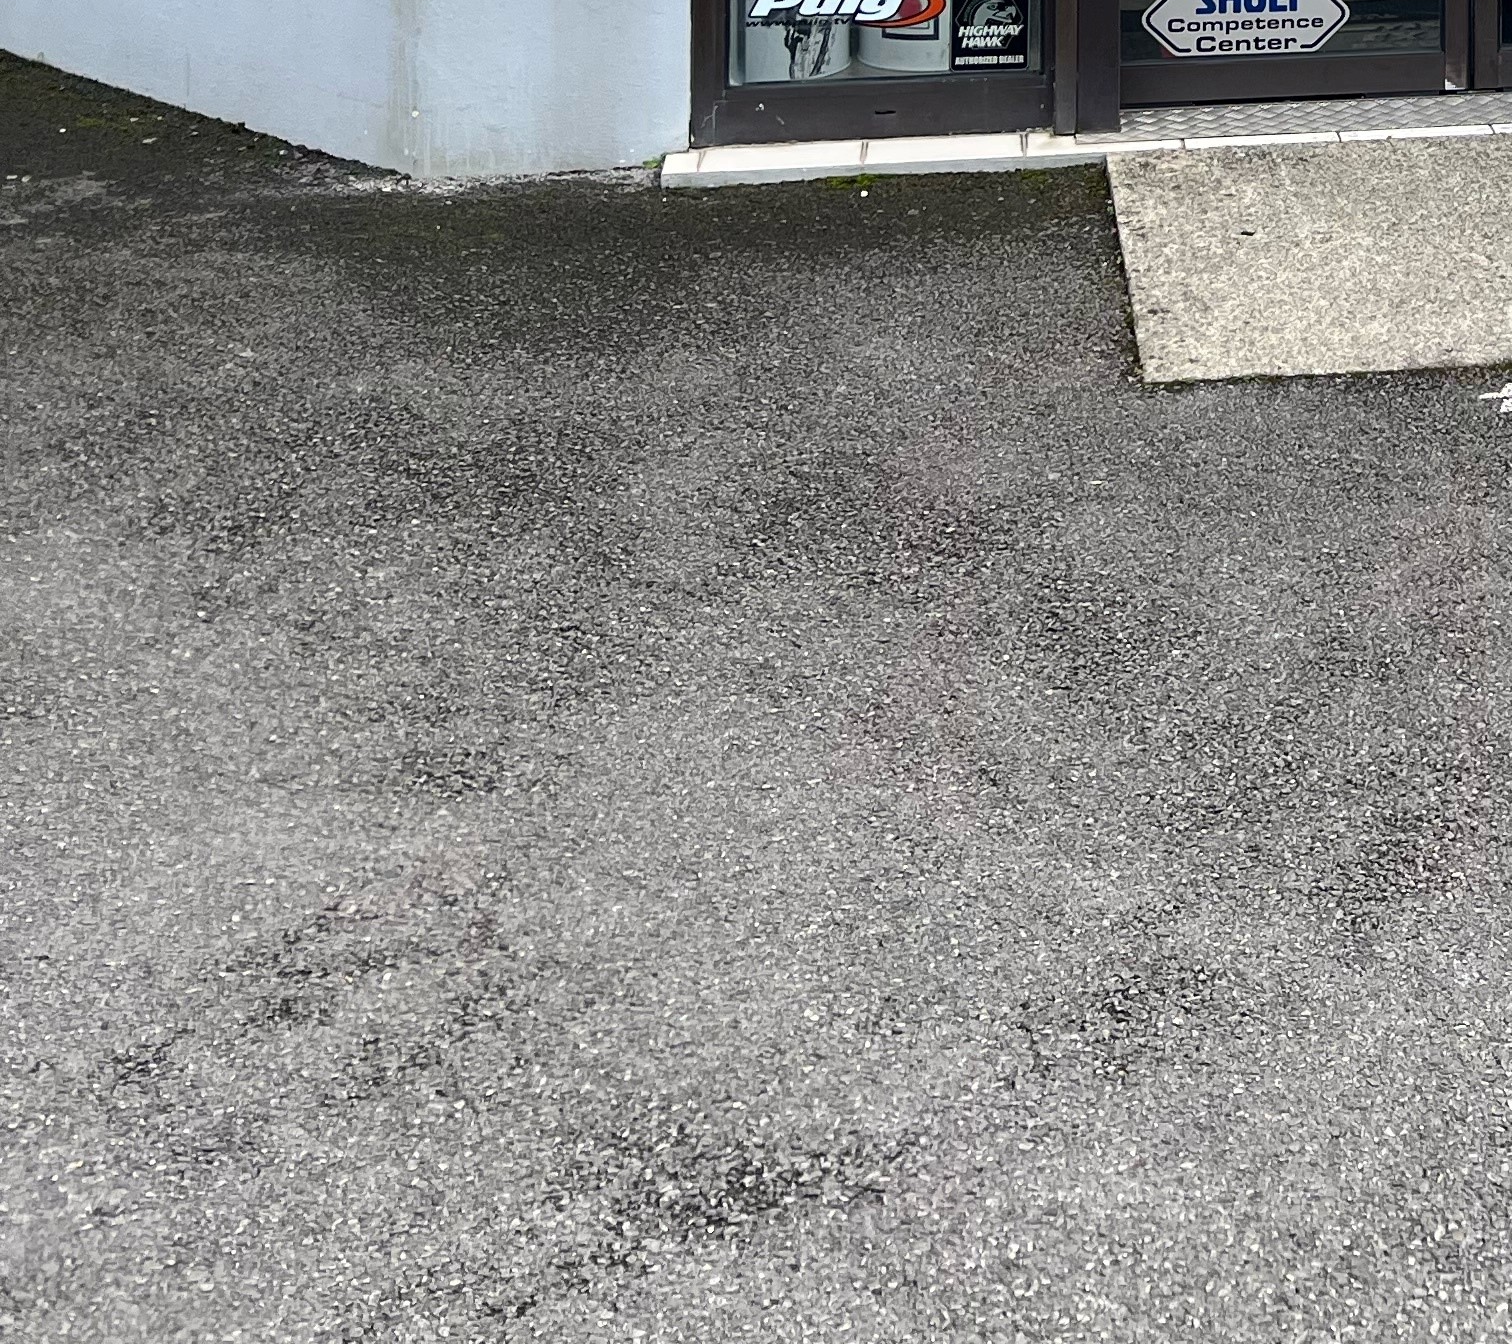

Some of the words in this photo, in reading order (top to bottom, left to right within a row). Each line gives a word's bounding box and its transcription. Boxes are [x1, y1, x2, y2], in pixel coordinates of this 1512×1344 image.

[958, 24, 1025, 38] HIGHWAY
[1167, 16, 1325, 35] Competence
[961, 36, 1004, 49] HAWK
[1195, 35, 1298, 53] Center
[955, 55, 998, 66] AUTHORIZED
[999, 54, 1024, 64] DEALER
